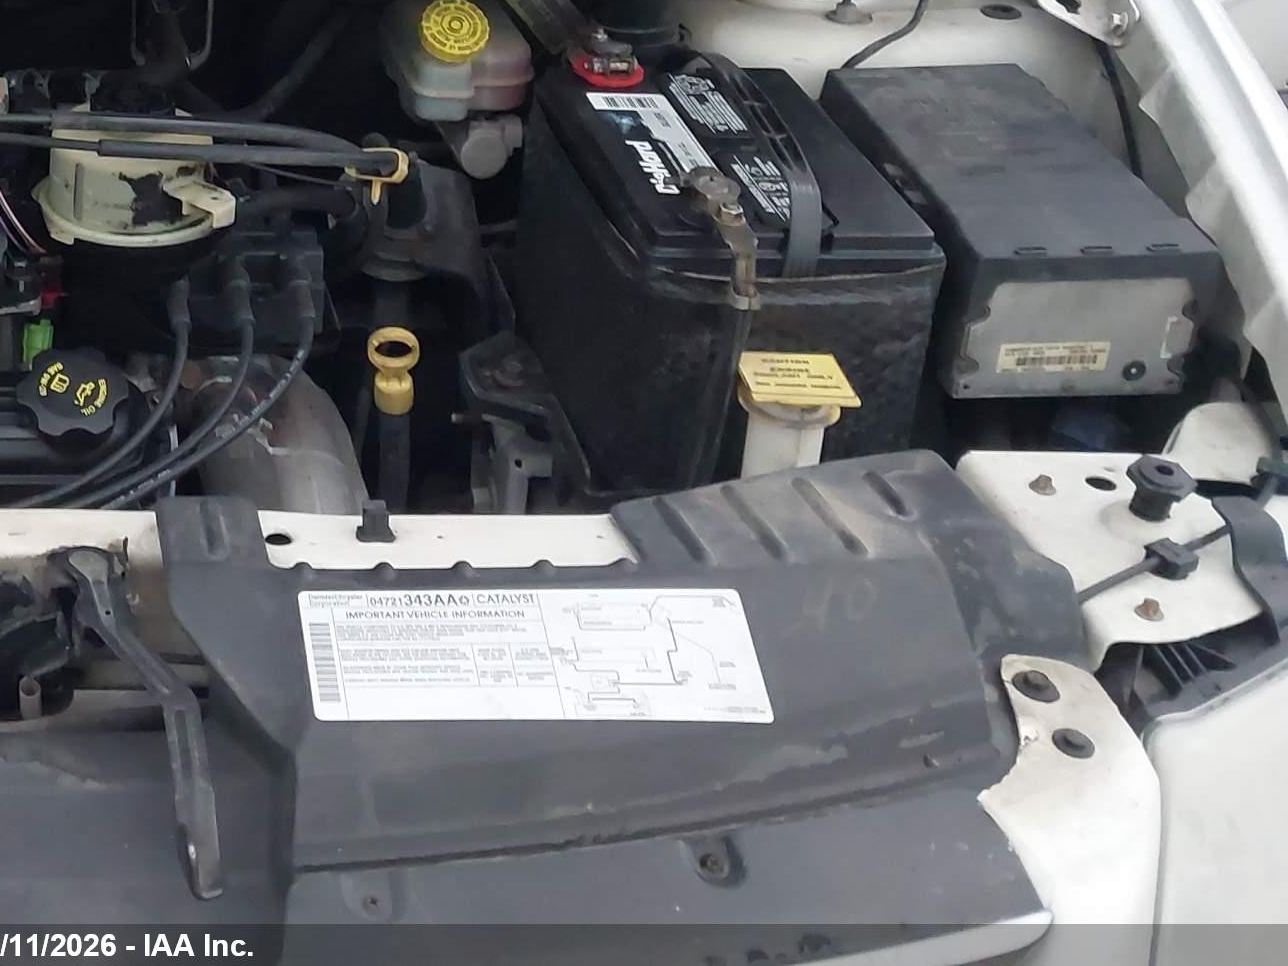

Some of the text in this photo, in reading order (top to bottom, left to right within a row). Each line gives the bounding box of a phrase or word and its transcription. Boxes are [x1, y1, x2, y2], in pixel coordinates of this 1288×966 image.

[624, 140, 680, 194] DieHard
[80, 378, 108, 417] ENGINE OIL
[477, 594, 535, 604] CATALYST
[345, 610, 525, 619] IMPORTANT VEHICLE INFORMATION
